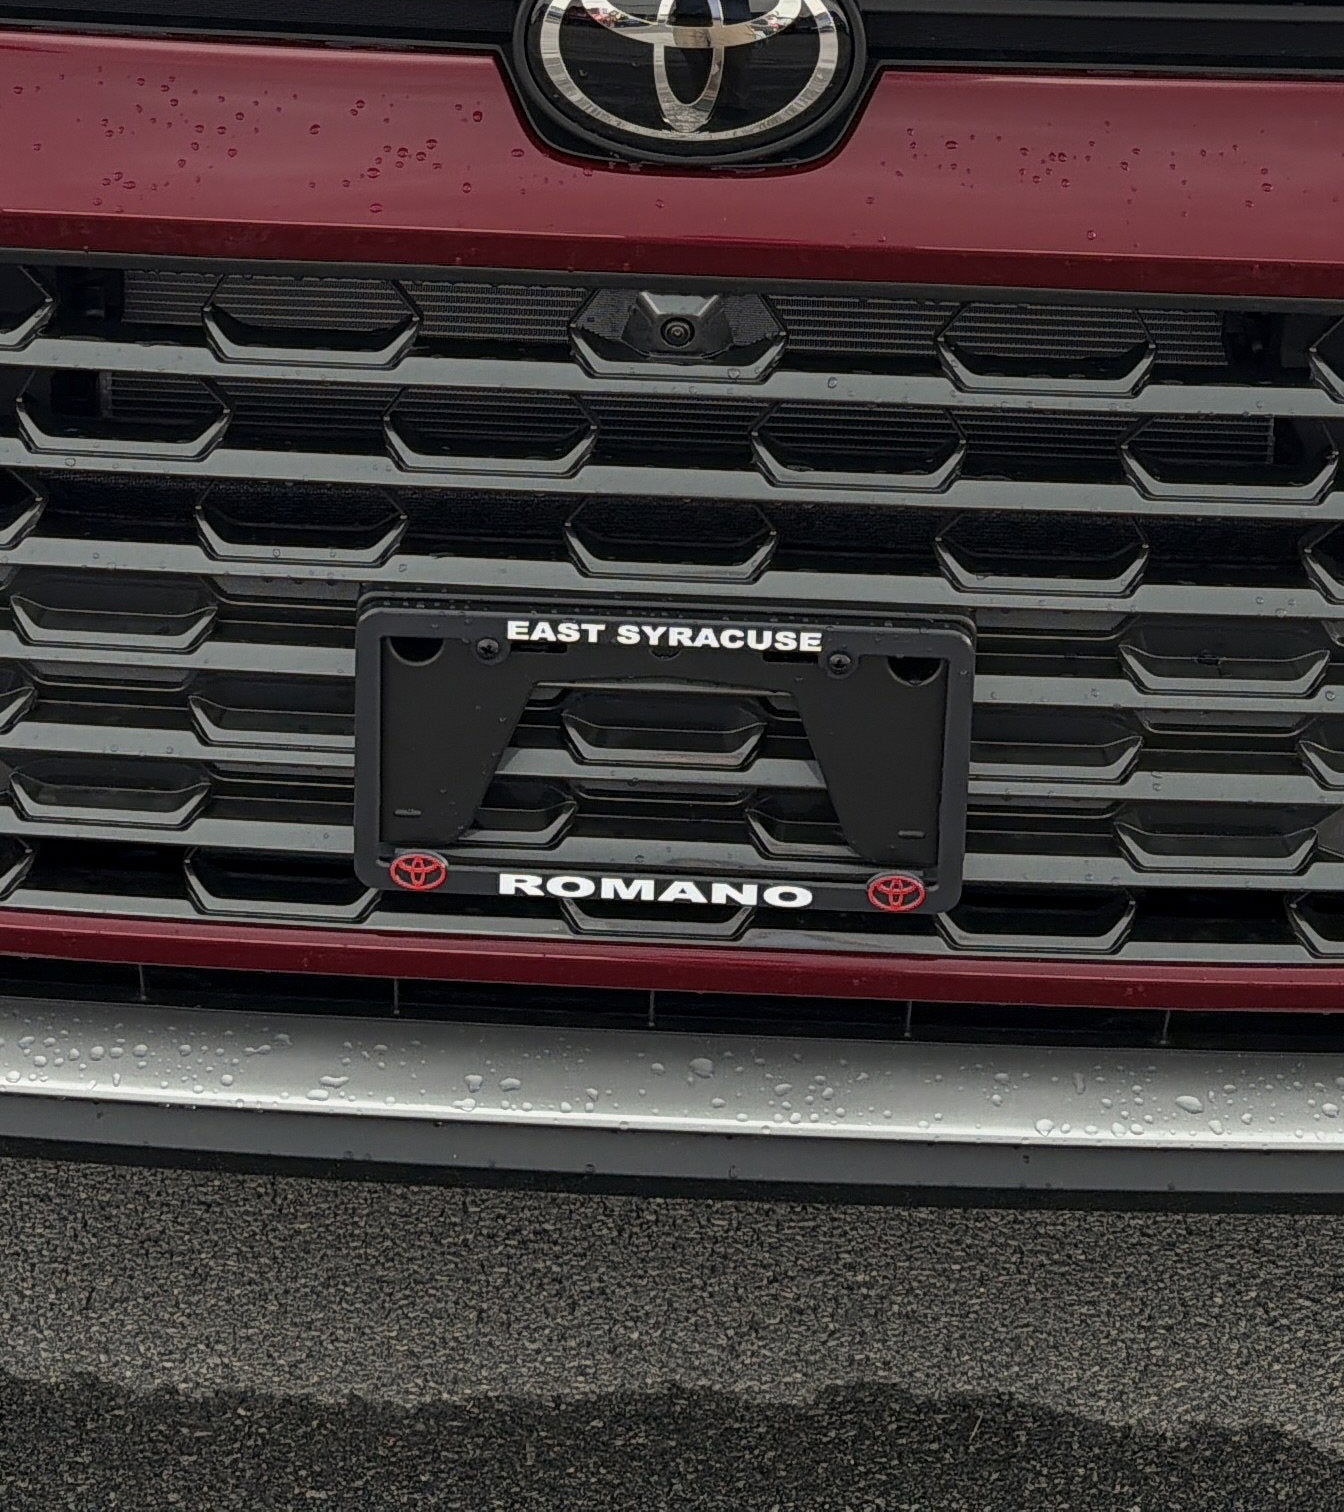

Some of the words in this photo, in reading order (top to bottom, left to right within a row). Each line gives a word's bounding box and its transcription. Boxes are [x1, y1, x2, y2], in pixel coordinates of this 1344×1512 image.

[507, 620, 606, 643] EAST
[616, 624, 822, 652] SYRACUSE
[499, 873, 813, 908] ROMANO
